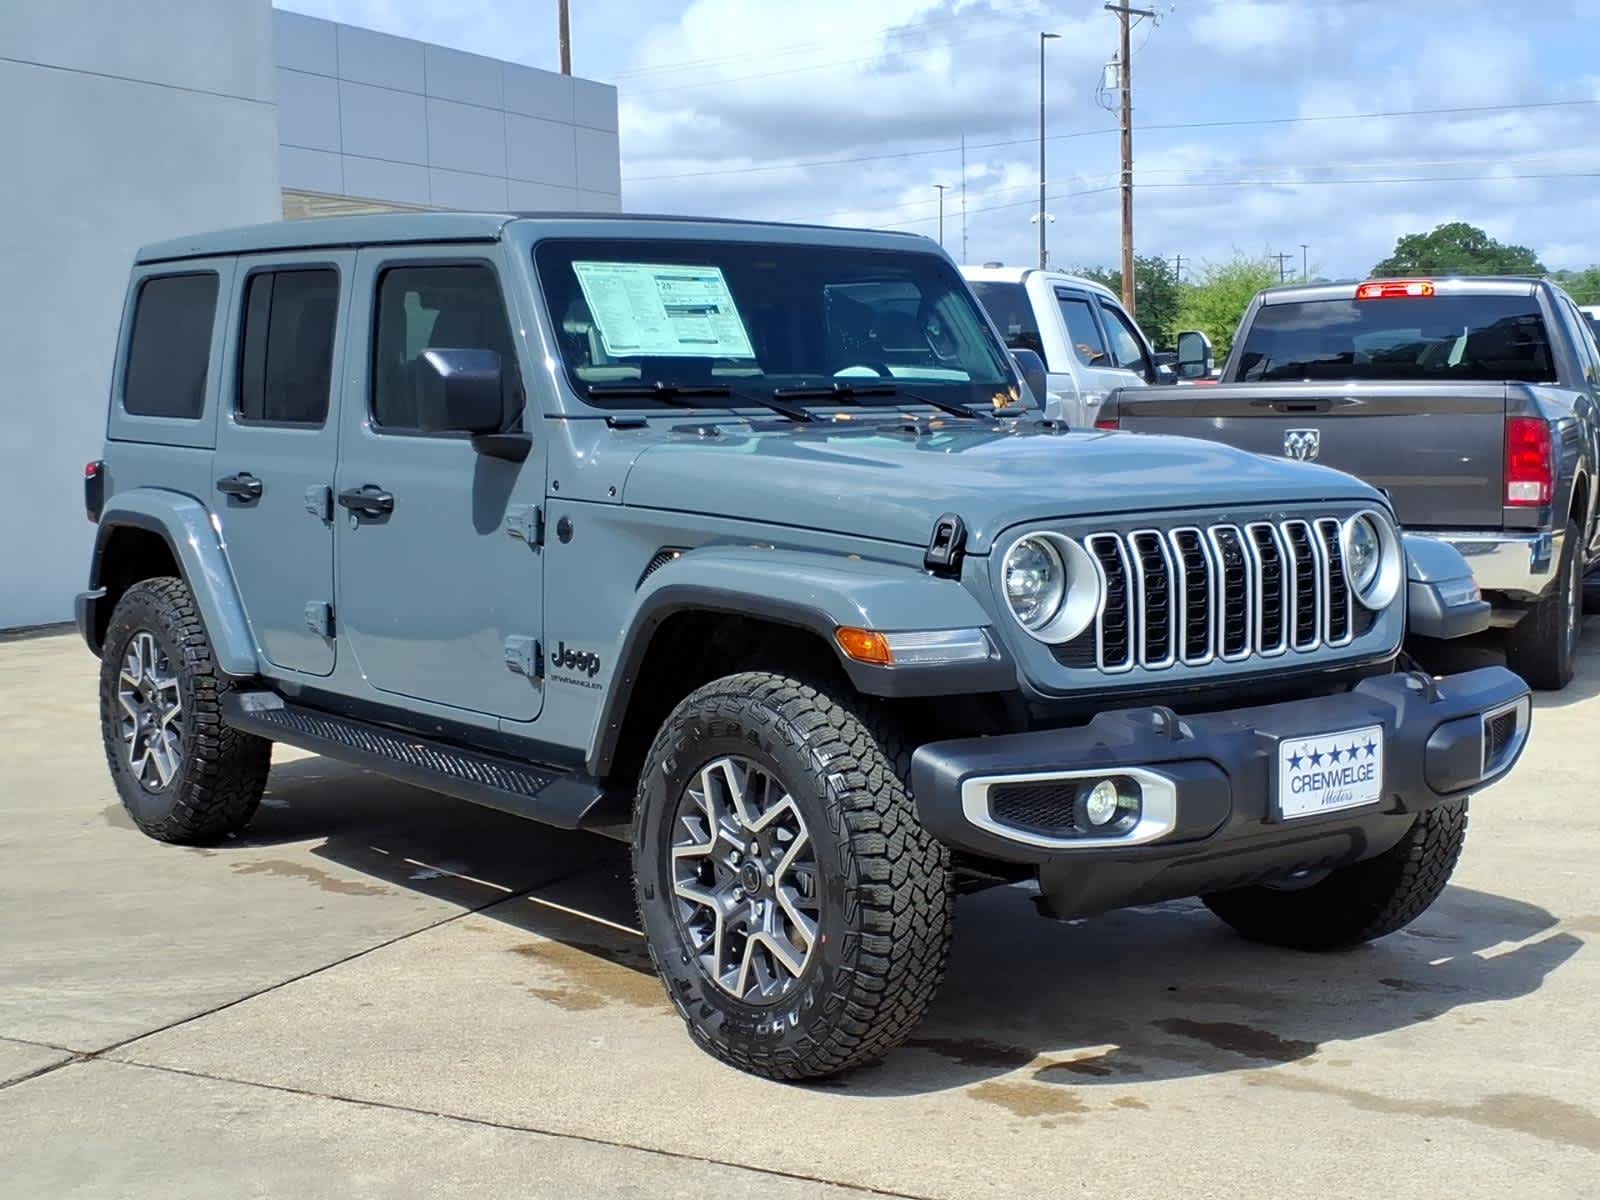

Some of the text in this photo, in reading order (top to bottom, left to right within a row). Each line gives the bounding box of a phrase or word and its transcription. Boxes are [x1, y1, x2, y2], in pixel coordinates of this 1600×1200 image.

[551, 641, 601, 678] Jeep
[557, 676, 603, 690] WRANGLER
[1290, 762, 1375, 794] CRENWELGE
[1320, 787, 1354, 806] Motors
